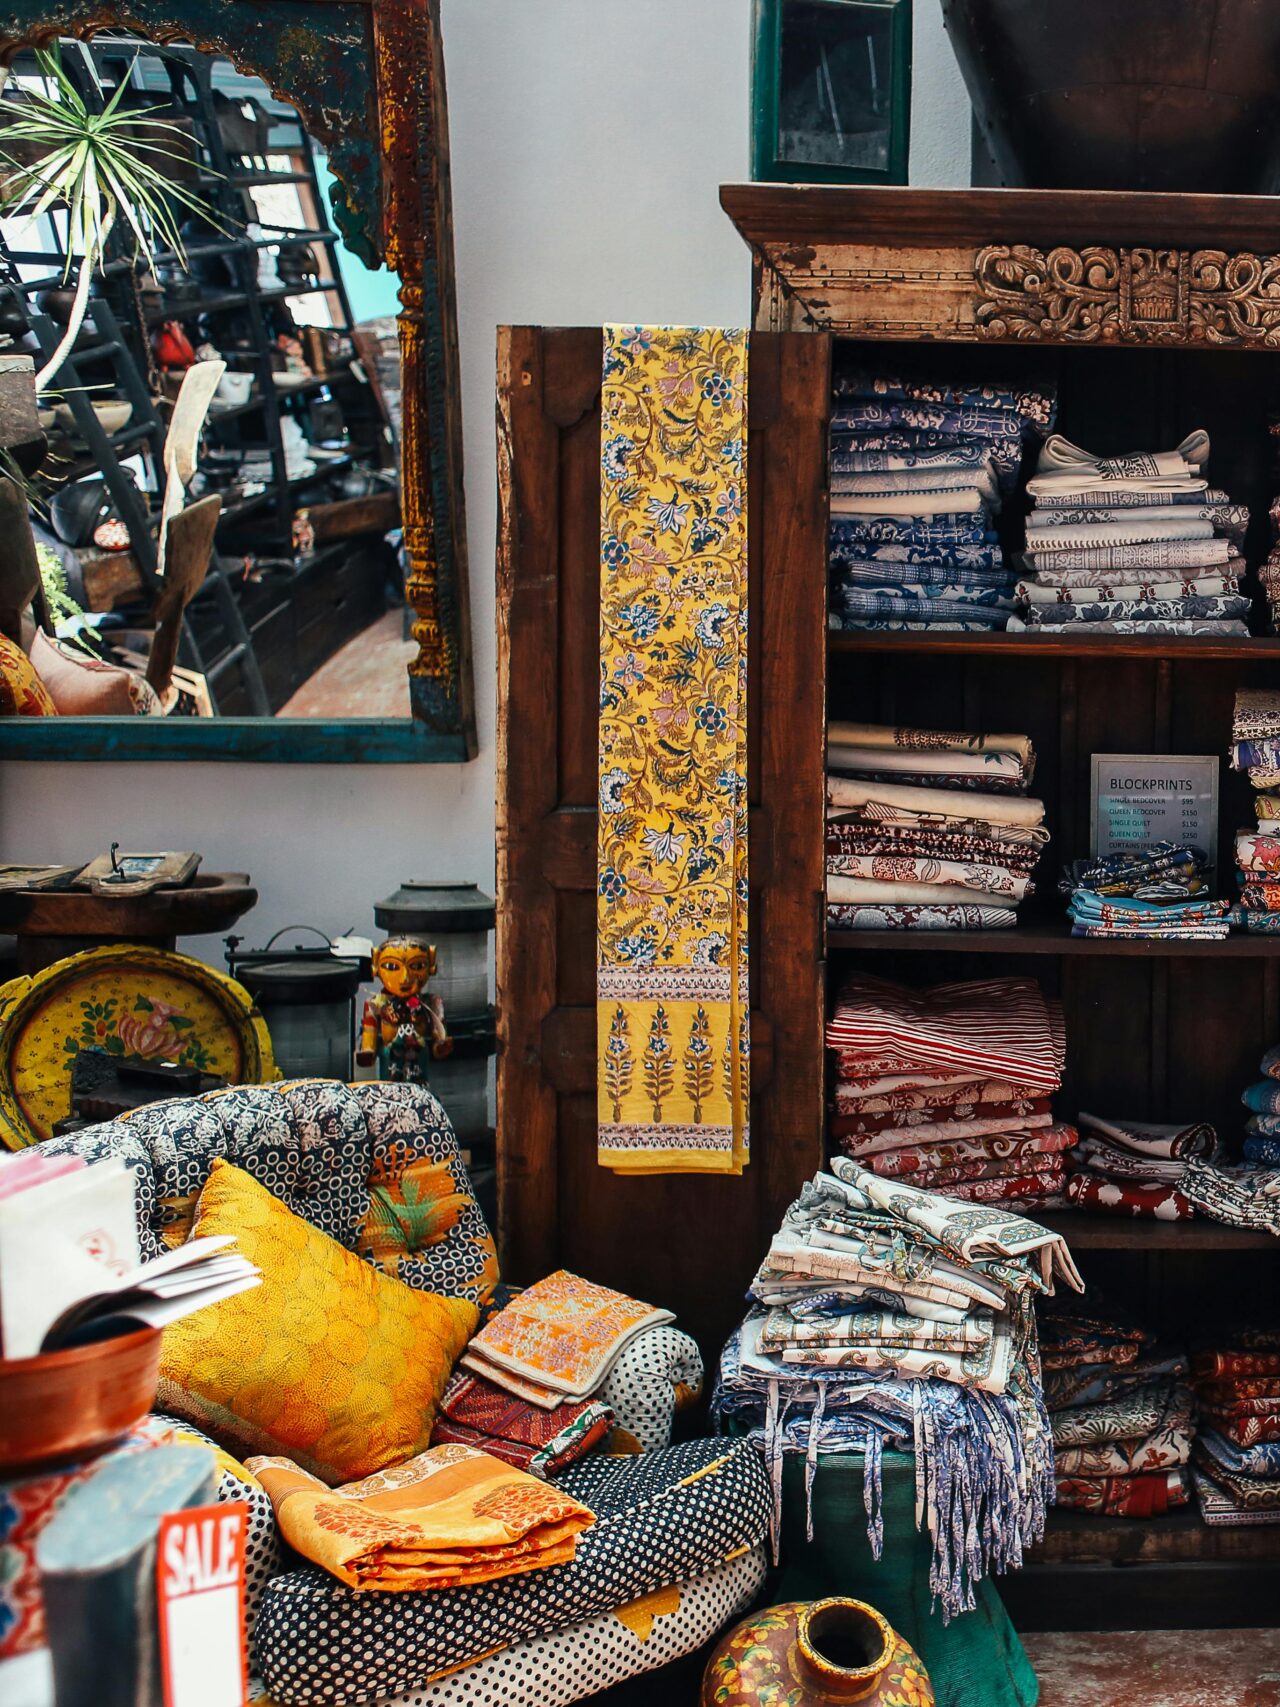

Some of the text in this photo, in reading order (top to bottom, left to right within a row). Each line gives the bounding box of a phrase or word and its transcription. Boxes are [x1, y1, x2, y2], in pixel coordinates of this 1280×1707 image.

[1110, 778, 1193, 791] BLOCKPRINTS
[1181, 809, 1198, 817] $150
[164, 1514, 241, 1596] SALE
